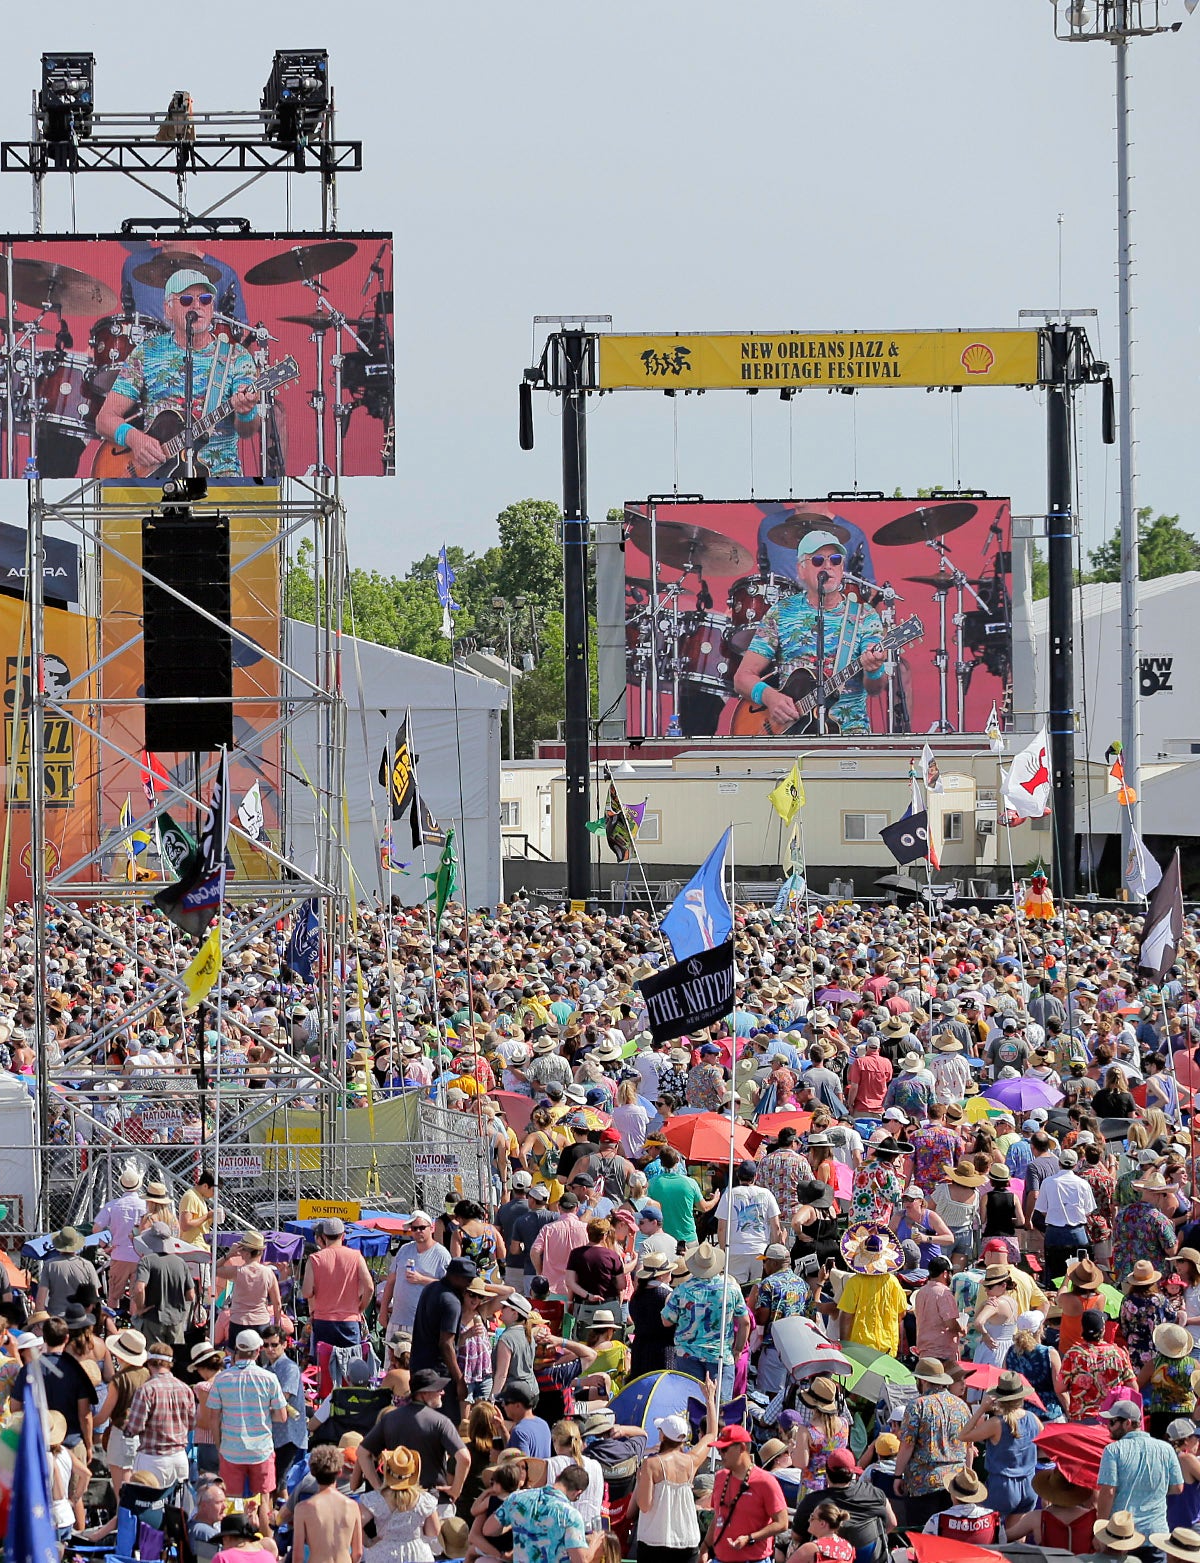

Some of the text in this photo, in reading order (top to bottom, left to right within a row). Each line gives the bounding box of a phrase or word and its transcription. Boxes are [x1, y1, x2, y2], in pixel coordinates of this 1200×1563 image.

[741, 341, 899, 360] NEW ORLEANS JAZZ &
[741, 361, 901, 379] HERITAGE FESTIVAL
[7, 567, 68, 577] ACRA
[647, 964, 733, 1026] THE NATCH
[143, 1109, 181, 1120] NATIONAL
[218, 1156, 261, 1167] NATIONAL
[415, 1154, 459, 1164] NATIONL
[311, 1206, 348, 1214] NO SITTING
